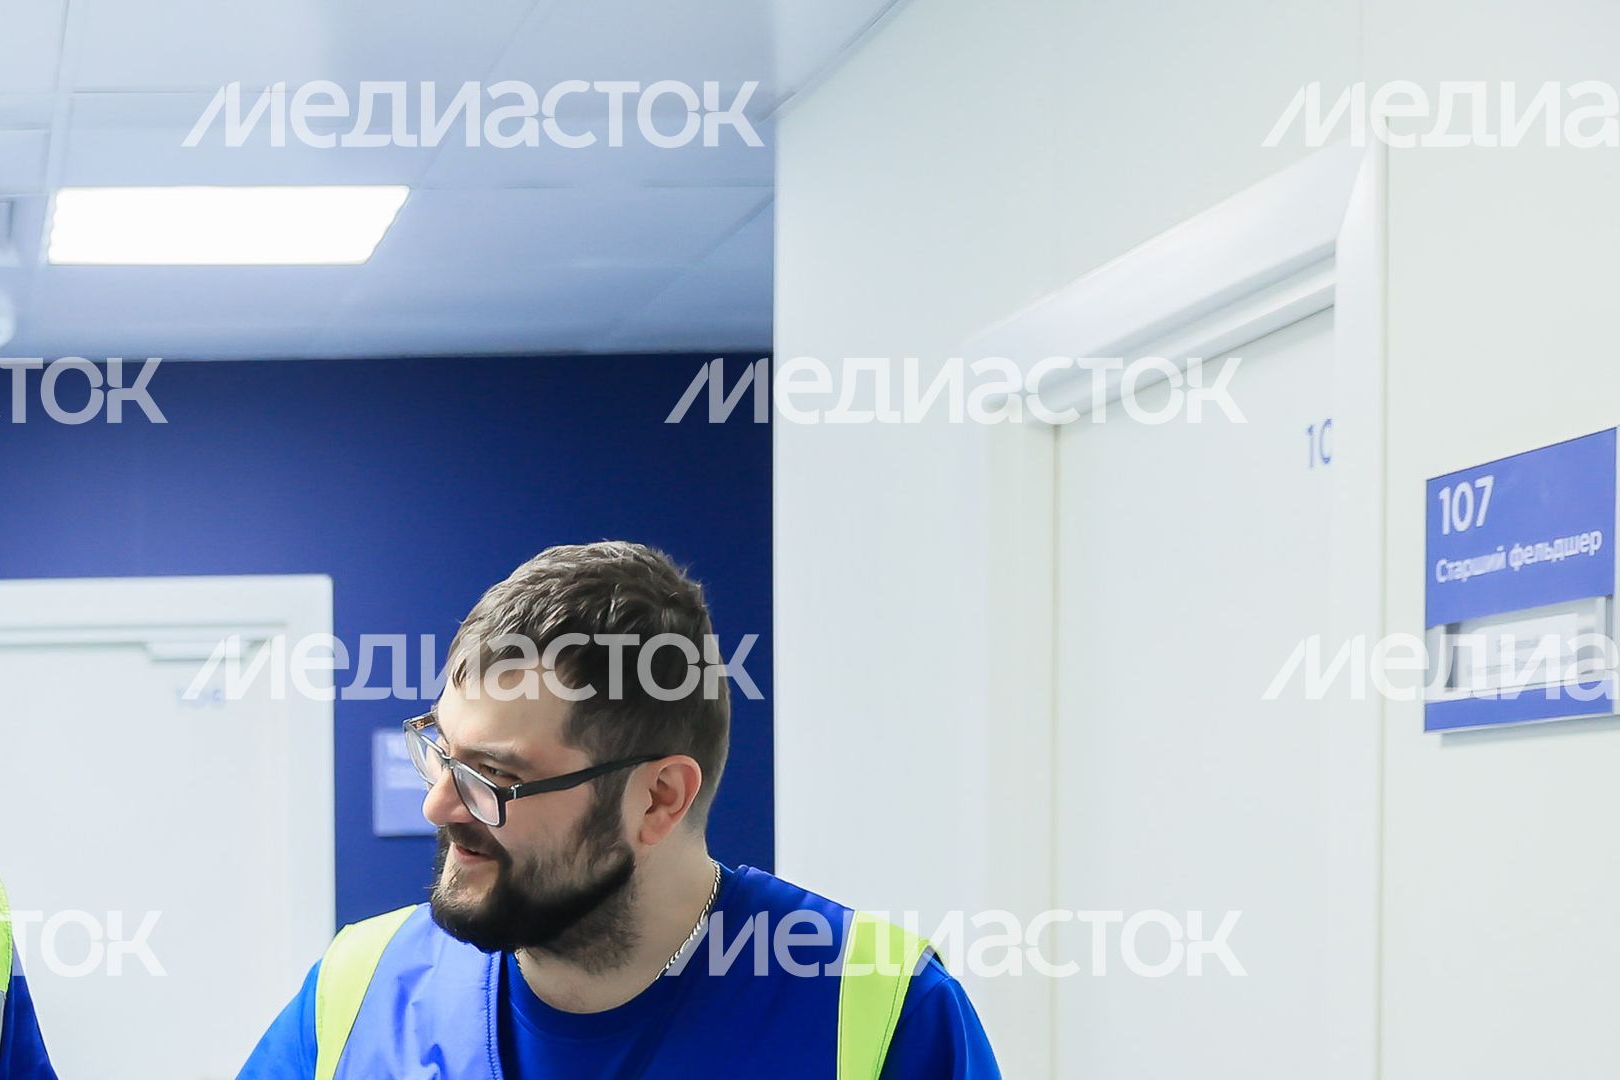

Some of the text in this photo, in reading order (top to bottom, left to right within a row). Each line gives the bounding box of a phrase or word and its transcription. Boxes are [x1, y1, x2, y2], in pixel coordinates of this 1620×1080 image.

[1438, 475, 1495, 536] 107
[1436, 528, 1604, 584] Старший фельдшер
